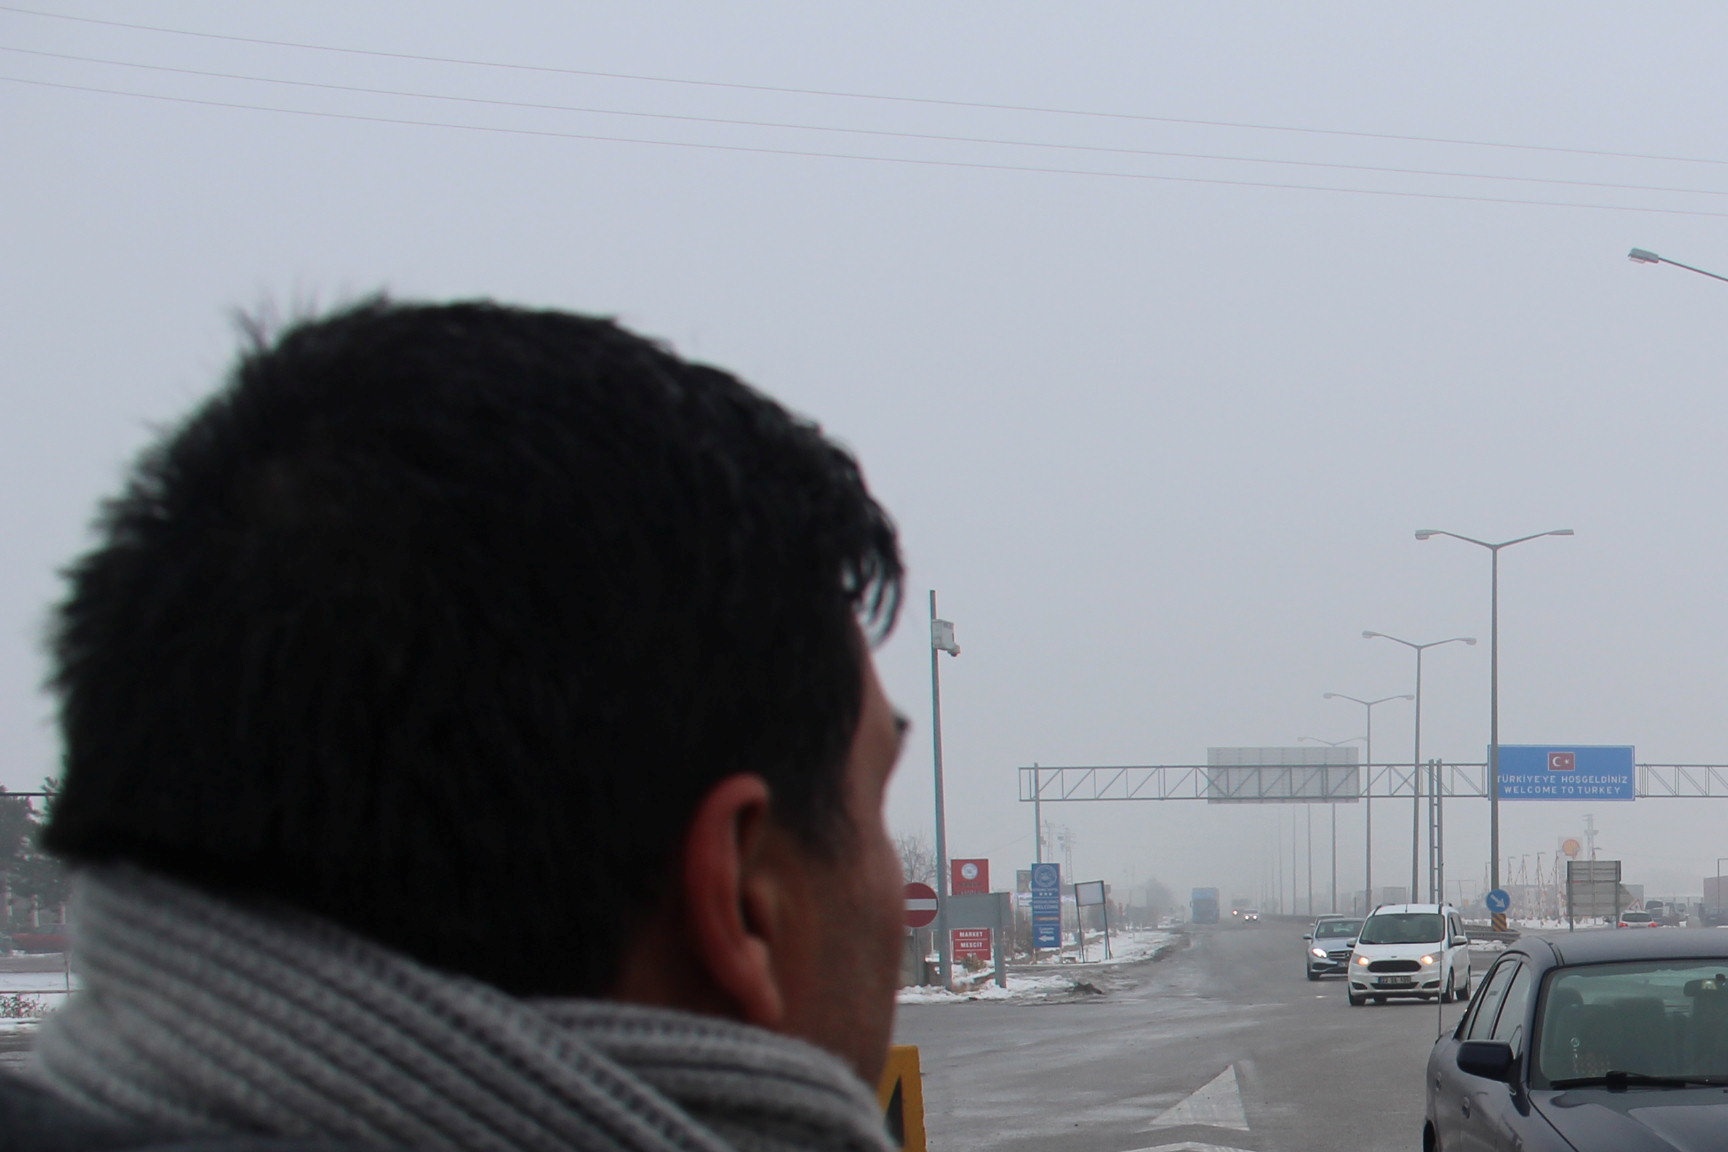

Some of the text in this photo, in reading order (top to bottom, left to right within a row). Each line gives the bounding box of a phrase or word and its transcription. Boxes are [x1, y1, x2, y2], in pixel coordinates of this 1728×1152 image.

[1504, 786, 1620, 794] WELCOME TO TURKEY
